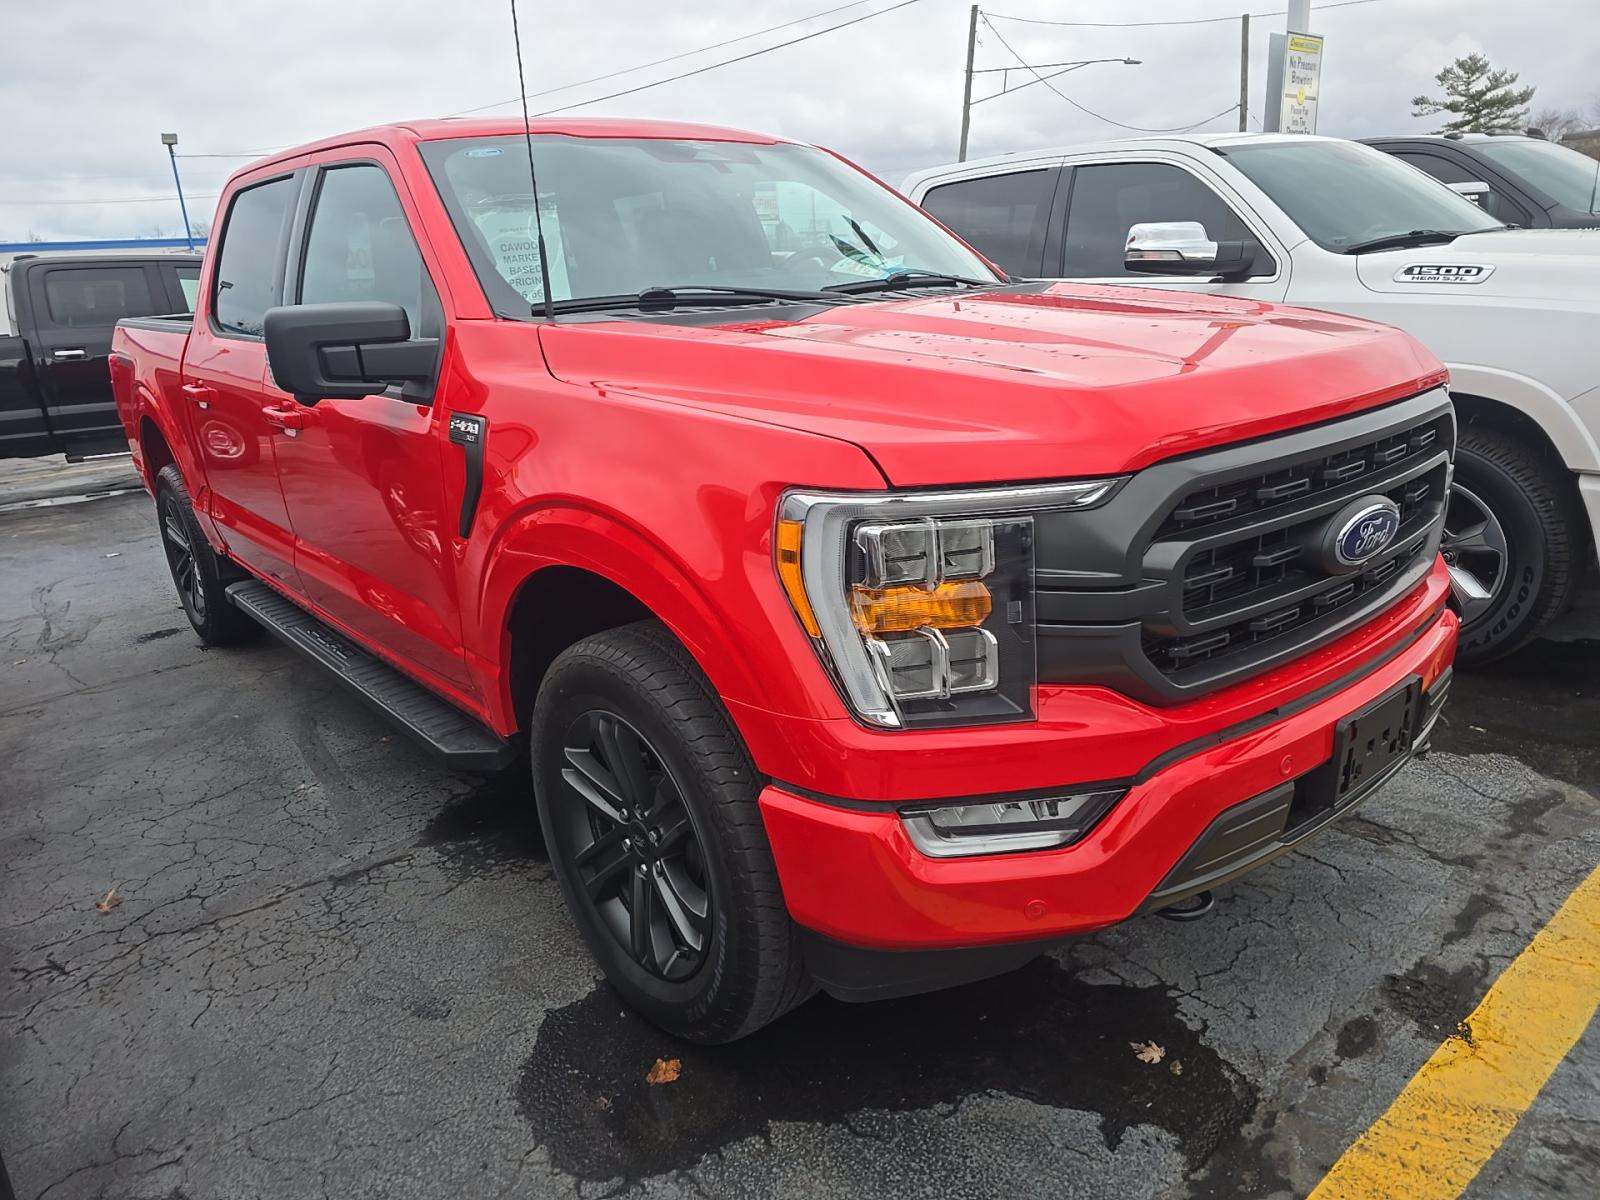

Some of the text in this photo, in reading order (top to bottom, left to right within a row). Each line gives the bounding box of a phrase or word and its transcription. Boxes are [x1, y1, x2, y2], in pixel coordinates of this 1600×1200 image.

[500, 240, 539, 253] CAWOO
[503, 252, 540, 264] MARKE
[1412, 265, 1479, 276] 1500
[509, 276, 542, 288] PRICIN
[1354, 516, 1392, 555] Ford
[1471, 566, 1535, 646] GOODY
